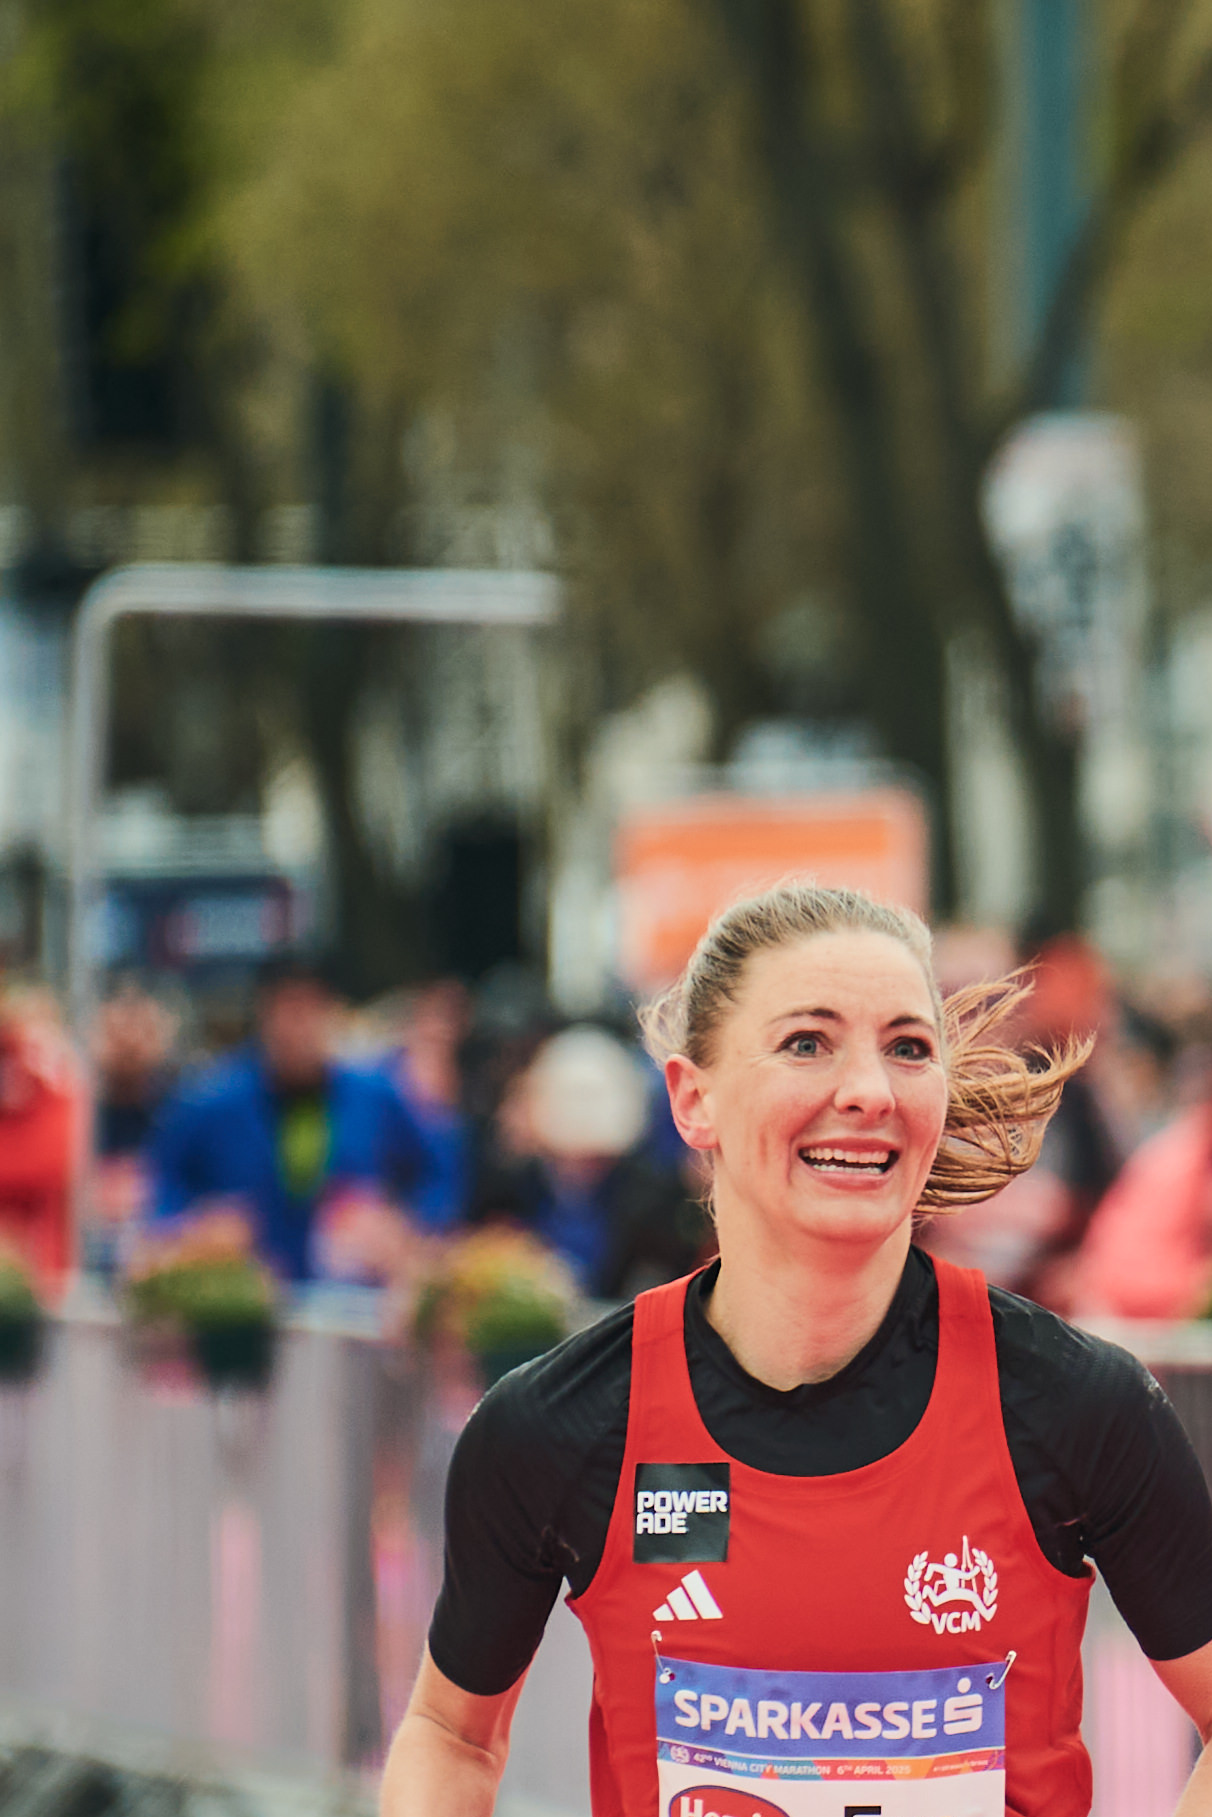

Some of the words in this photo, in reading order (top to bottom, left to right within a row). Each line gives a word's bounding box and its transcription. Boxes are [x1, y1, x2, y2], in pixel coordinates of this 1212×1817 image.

[637, 1491, 728, 1512] POWER
[636, 1512, 688, 1534] ADE
[931, 1611, 981, 1634] VCM
[674, 1689, 937, 1740] SPARKASSE
[714, 1757, 748, 1772] VIENNA
[749, 1763, 773, 1773] CITY
[774, 1764, 831, 1775] MARATHON
[854, 1765, 884, 1775] APRIL
[885, 1765, 912, 1775] 2025
